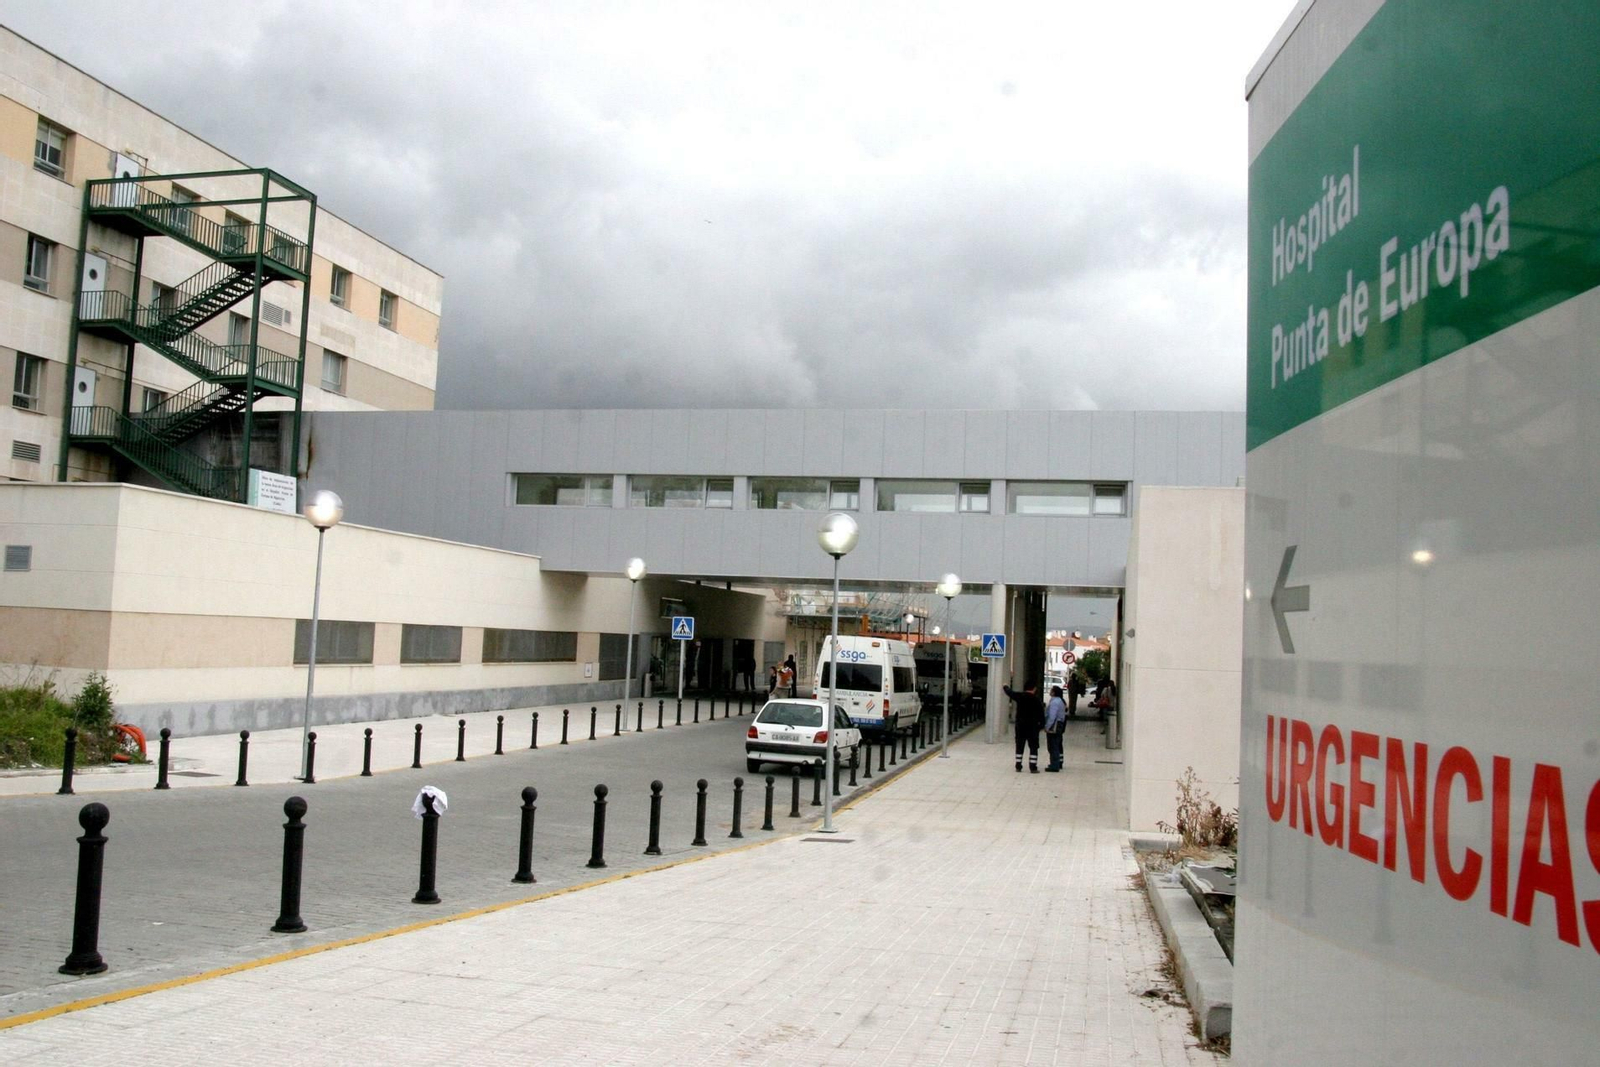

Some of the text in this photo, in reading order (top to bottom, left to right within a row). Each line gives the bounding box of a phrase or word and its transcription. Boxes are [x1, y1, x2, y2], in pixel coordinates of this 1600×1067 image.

[1271, 144, 1359, 287] Hospital
[1271, 184, 1510, 389] Punta de Europa
[840, 650, 866, 662] ssga
